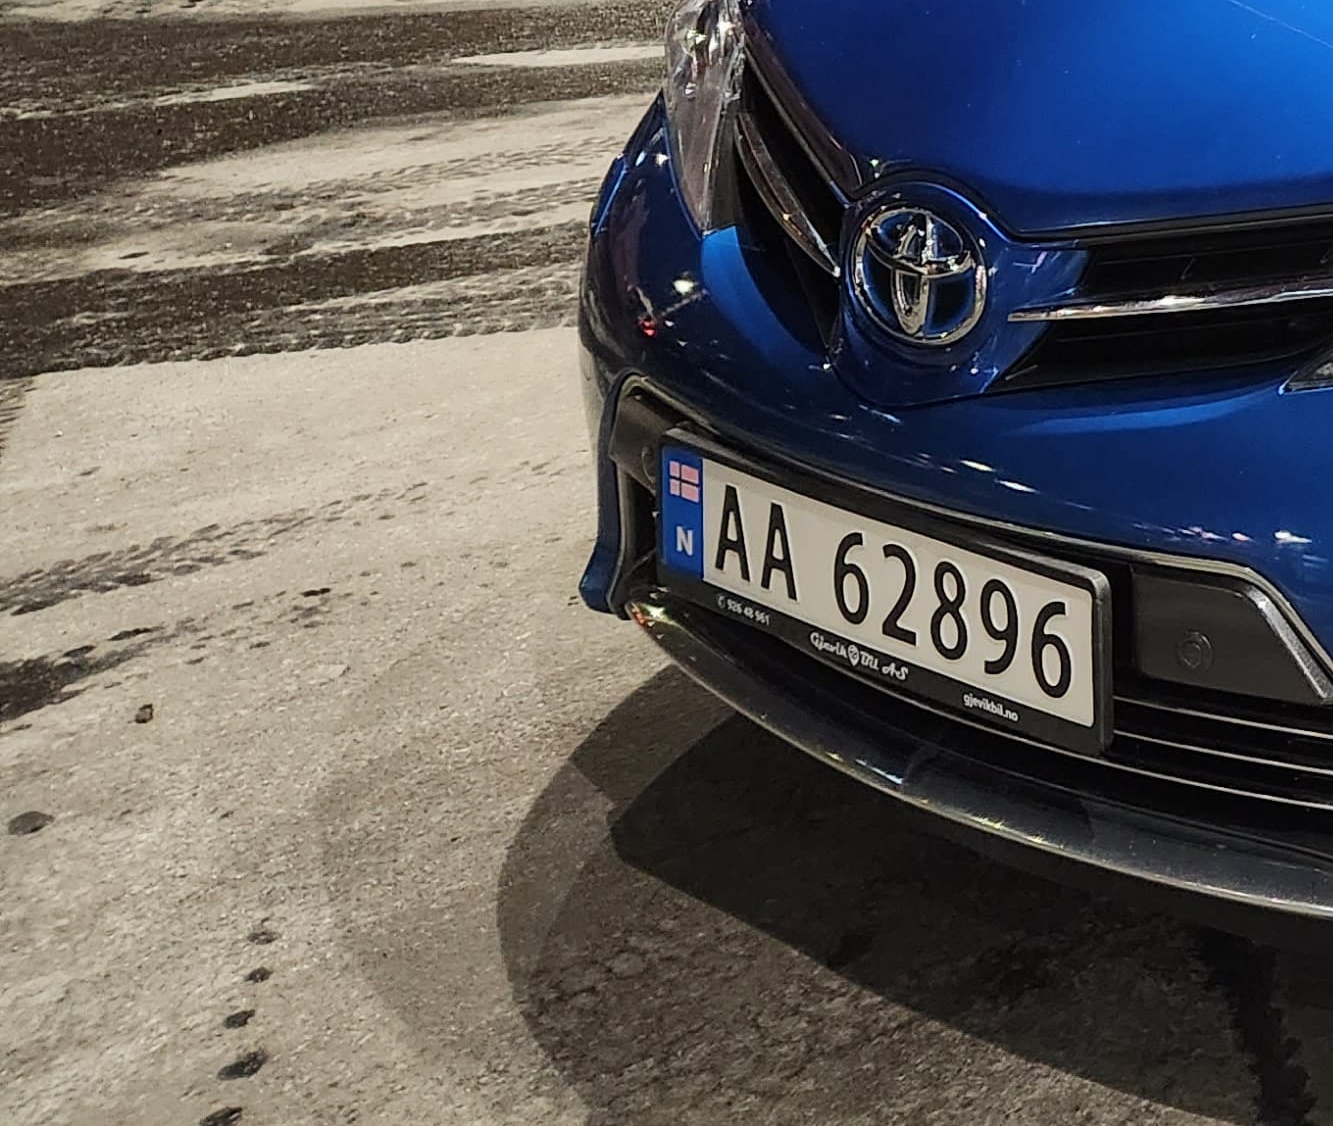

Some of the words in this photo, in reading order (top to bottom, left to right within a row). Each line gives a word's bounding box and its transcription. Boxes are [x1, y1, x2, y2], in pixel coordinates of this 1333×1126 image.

[676, 525, 694, 557] N
[714, 483, 798, 602] AA
[833, 531, 1073, 699] 62896
